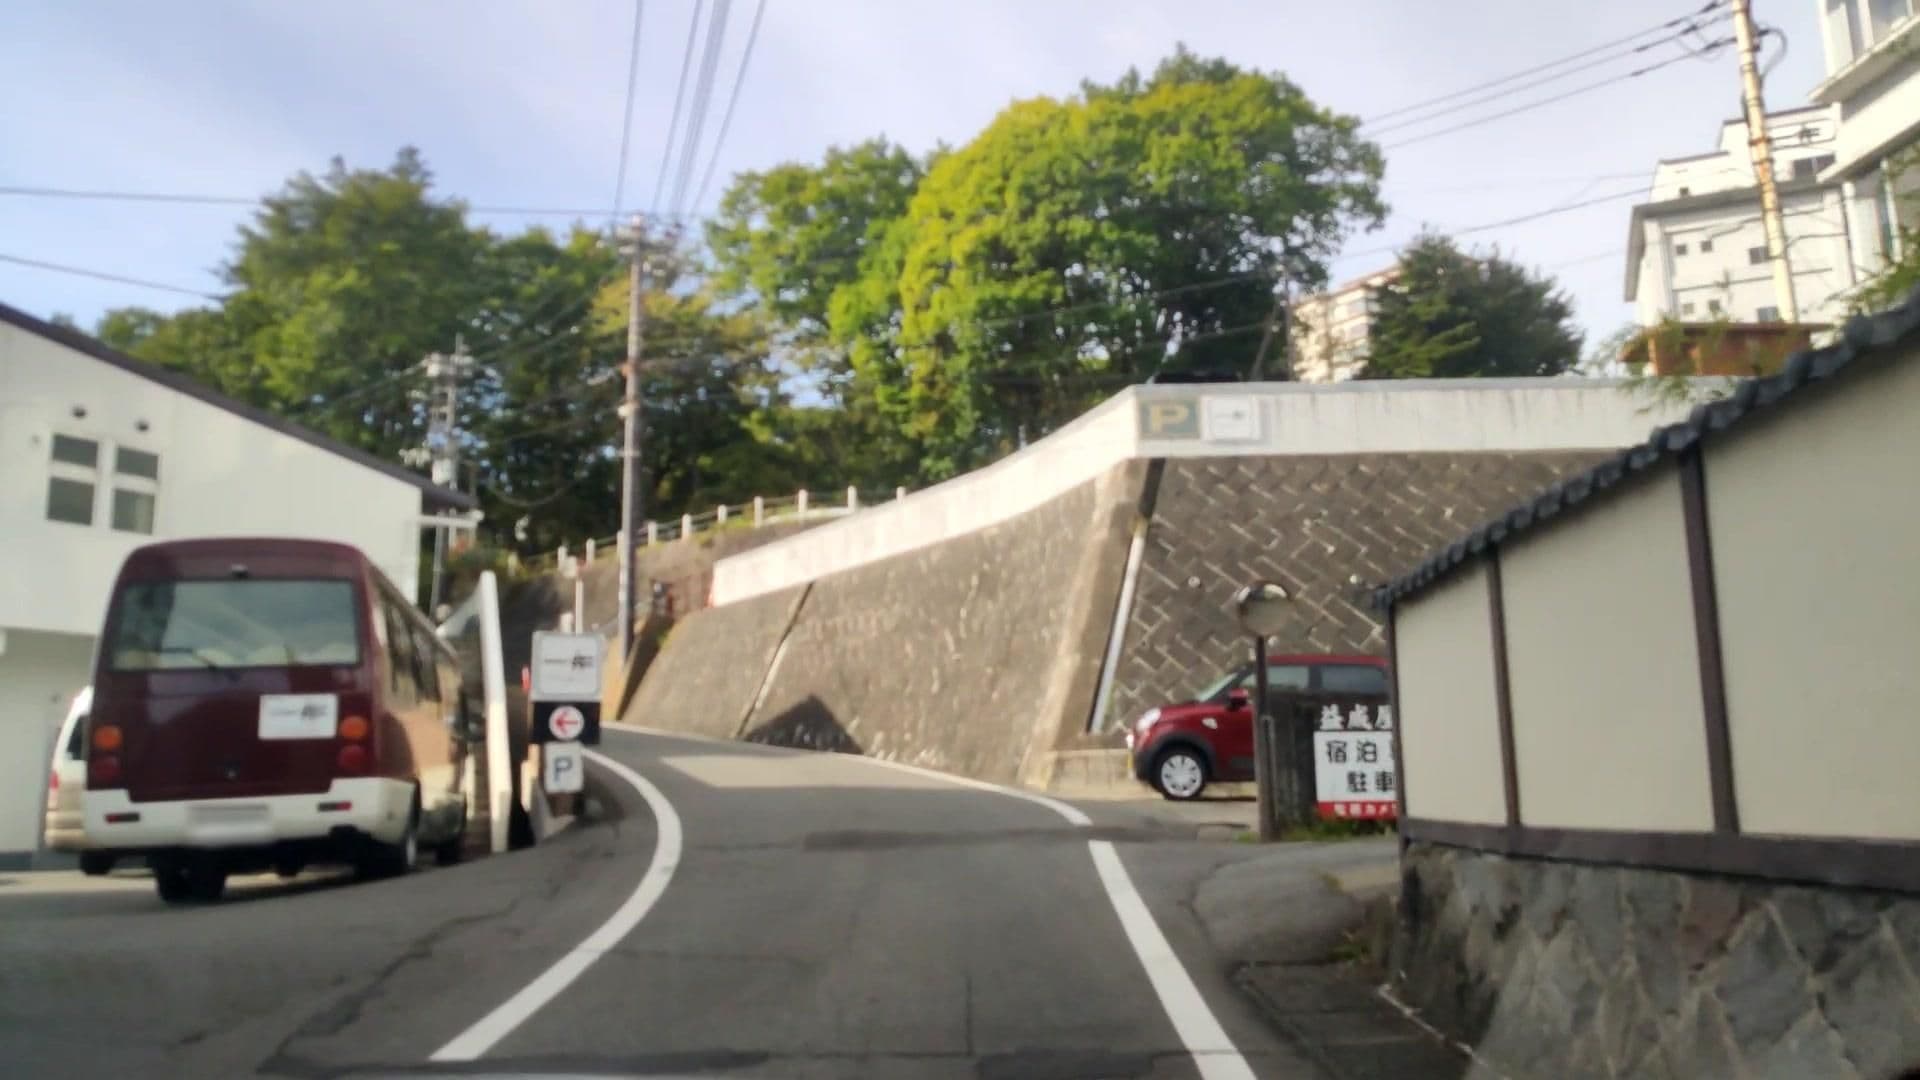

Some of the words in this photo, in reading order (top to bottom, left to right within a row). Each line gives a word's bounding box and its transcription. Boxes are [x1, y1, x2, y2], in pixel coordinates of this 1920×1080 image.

[1152, 405, 1189, 432] P
[1326, 740, 1393, 763] 宿泊
[553, 756, 573, 782] P
